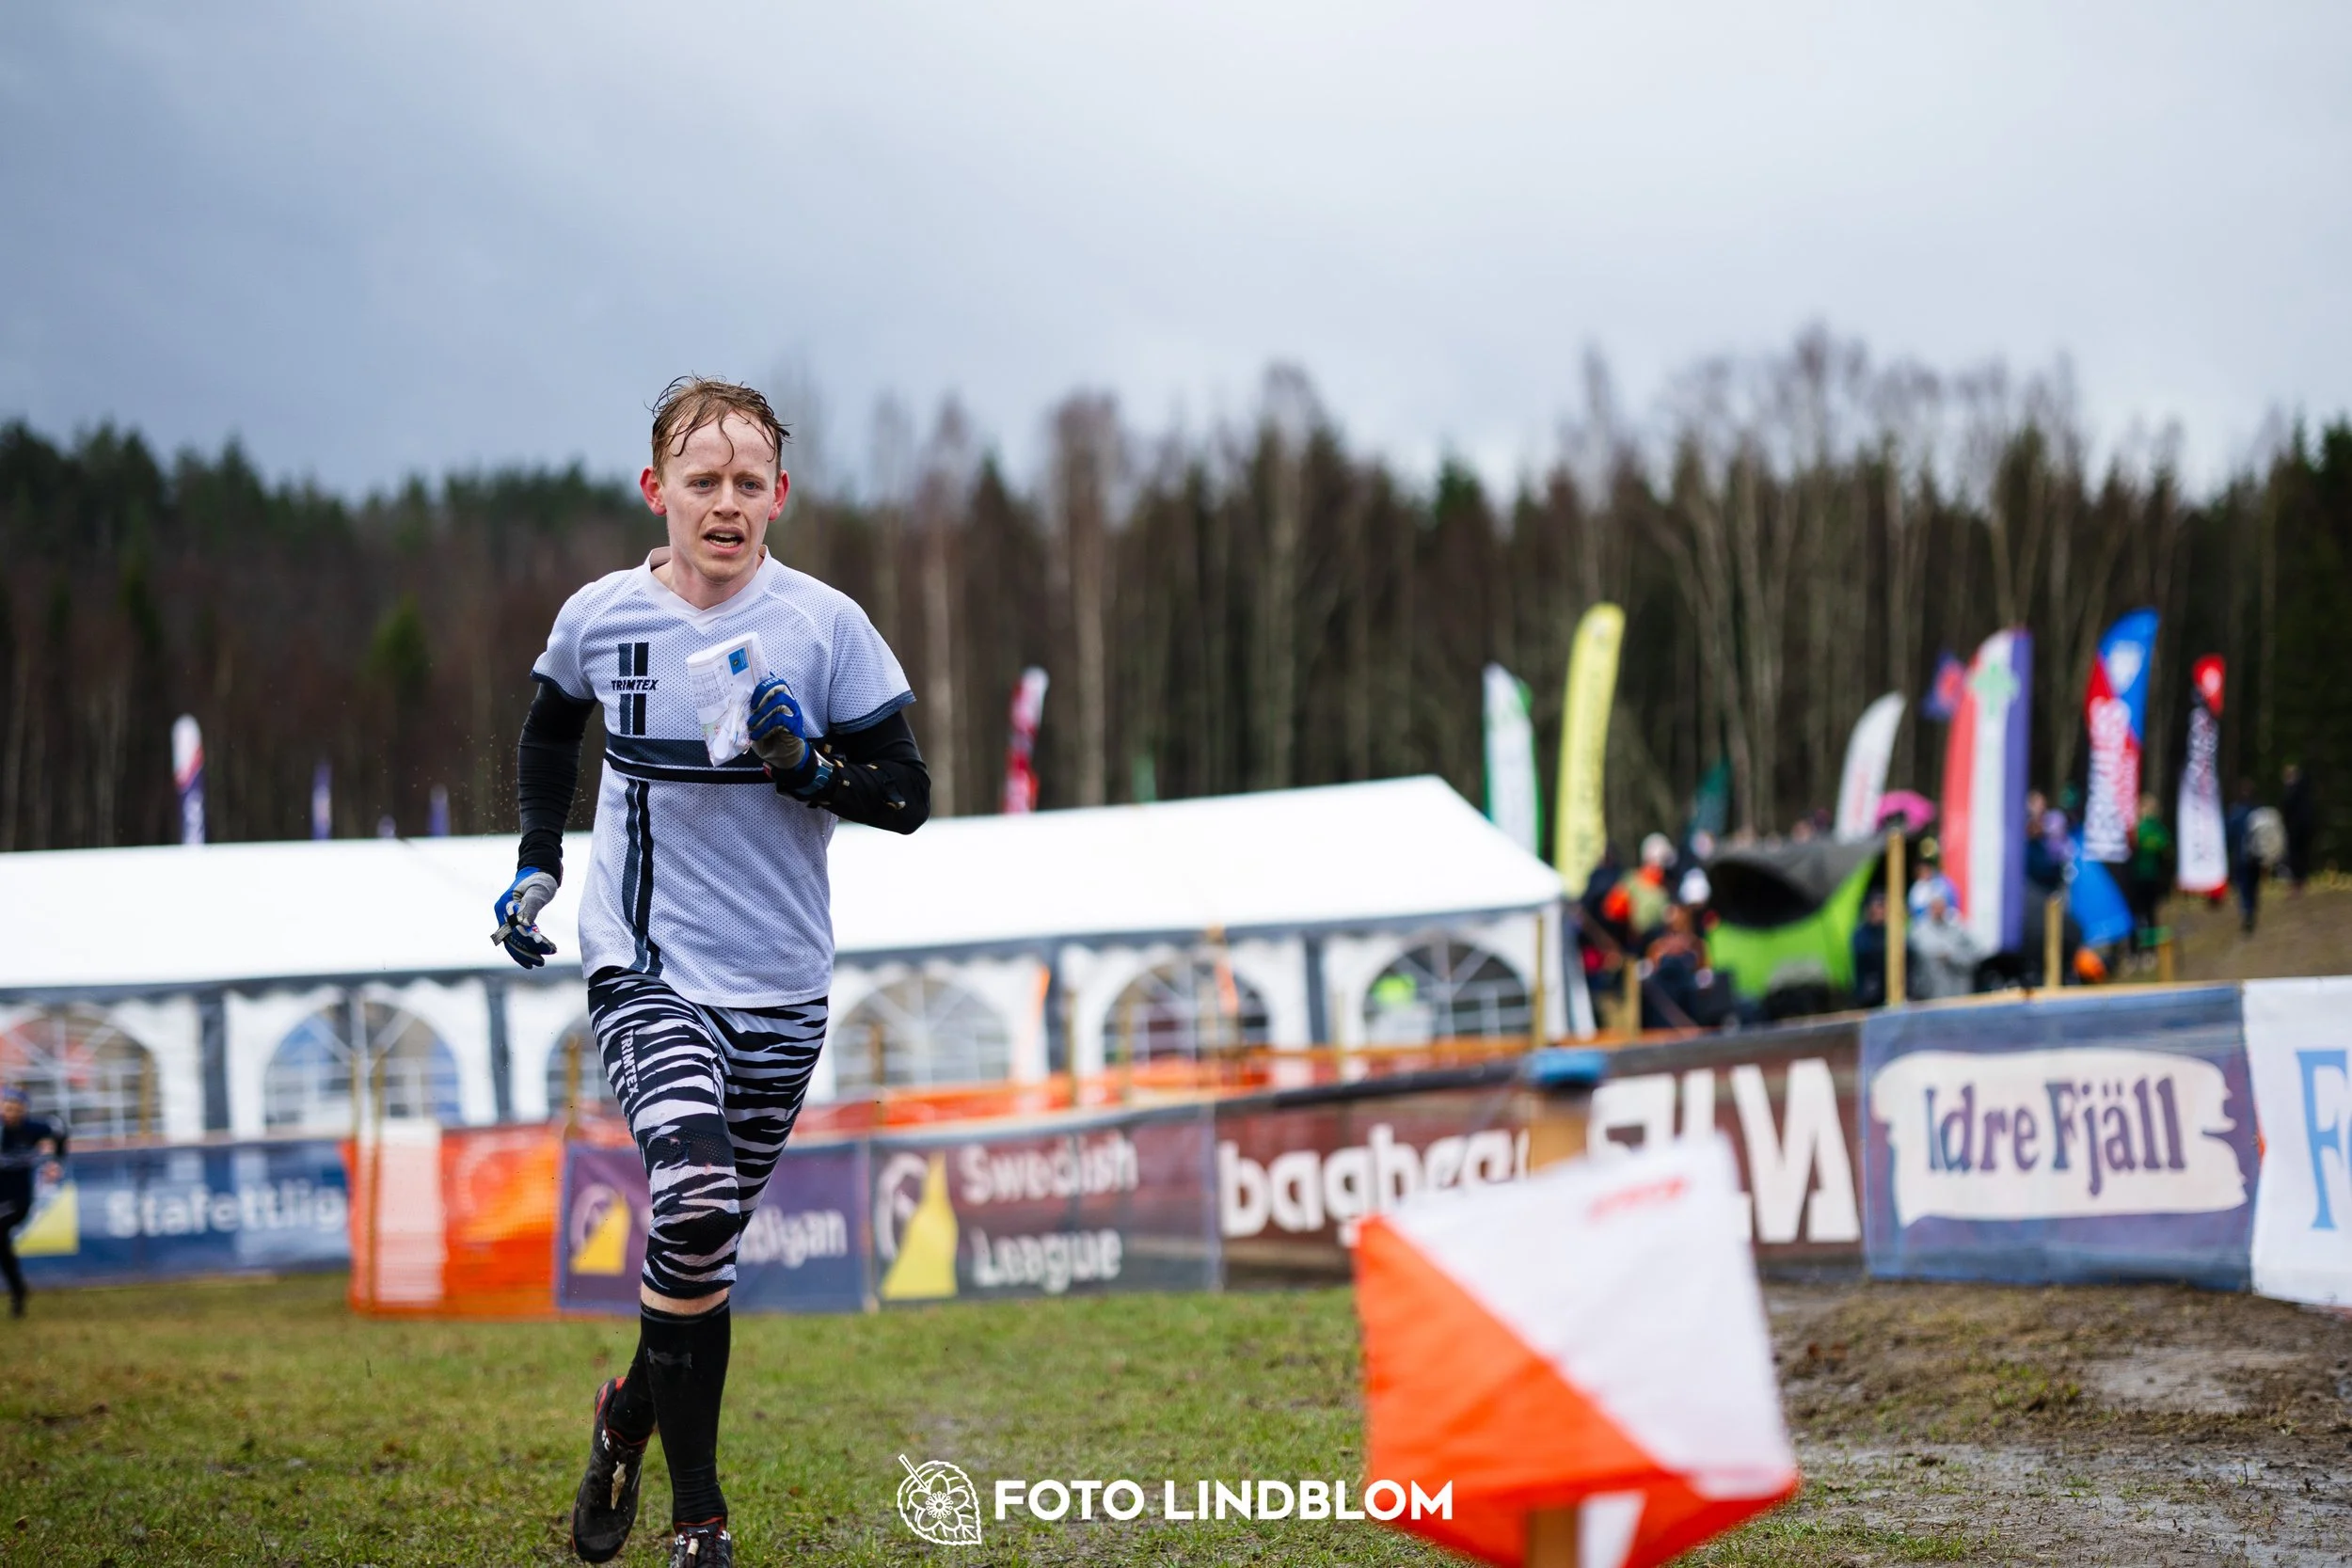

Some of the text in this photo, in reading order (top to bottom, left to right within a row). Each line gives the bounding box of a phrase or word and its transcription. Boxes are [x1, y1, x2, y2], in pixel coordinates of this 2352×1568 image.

[612, 679, 659, 690] TRIMTEX
[621, 1028, 640, 1099] TRIMTEX
[960, 1131, 1138, 1206] Swedish
[1923, 1075, 2187, 1197] Idre Fjäll
[2296, 1048, 2352, 1231] F
[104, 1178, 348, 1239] Stafettlig
[969, 1226, 1123, 1294] League
